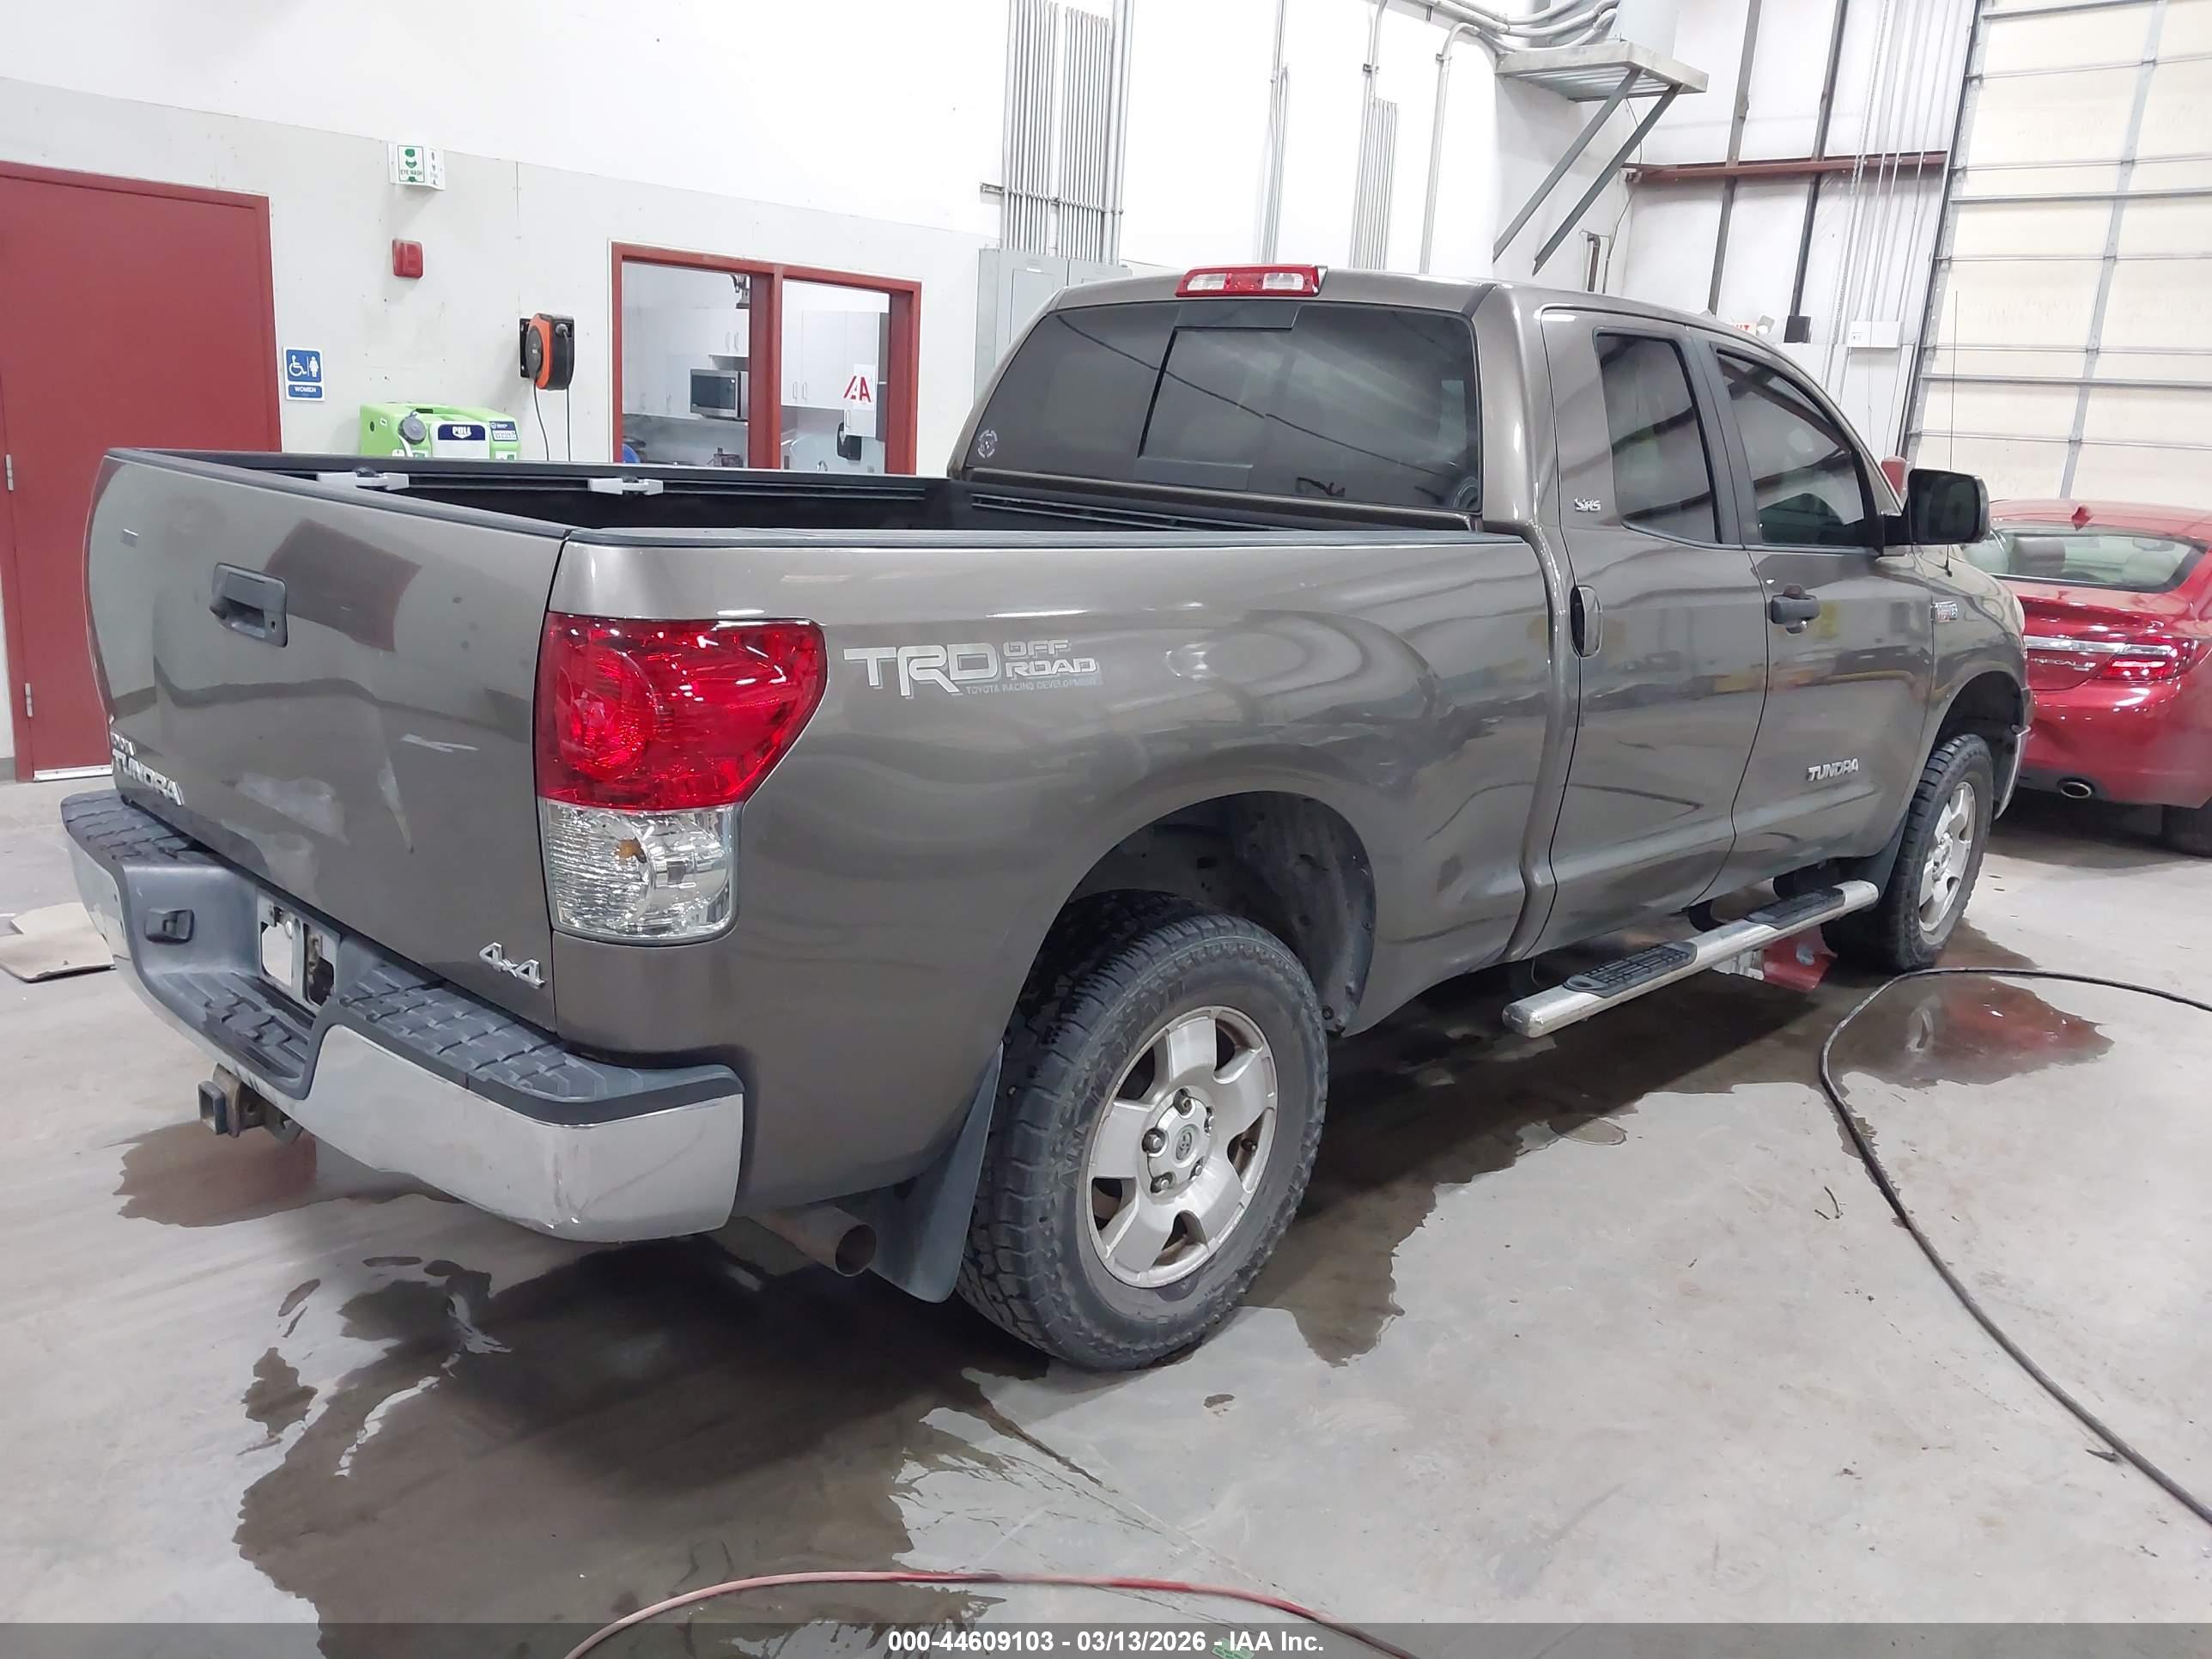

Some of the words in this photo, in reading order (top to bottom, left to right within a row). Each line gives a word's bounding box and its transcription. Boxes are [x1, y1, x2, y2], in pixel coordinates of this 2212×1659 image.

[452, 426, 471, 435] PULL
[843, 642, 1000, 698] TRD
[1003, 639, 1072, 659] OFF
[1005, 657, 1100, 680] ROAD
[966, 684, 1000, 695] TOYOTA
[1002, 681, 1036, 693] RACING
[112, 748, 184, 805] TUNDRA
[1807, 758, 1859, 782] TUNDRA
